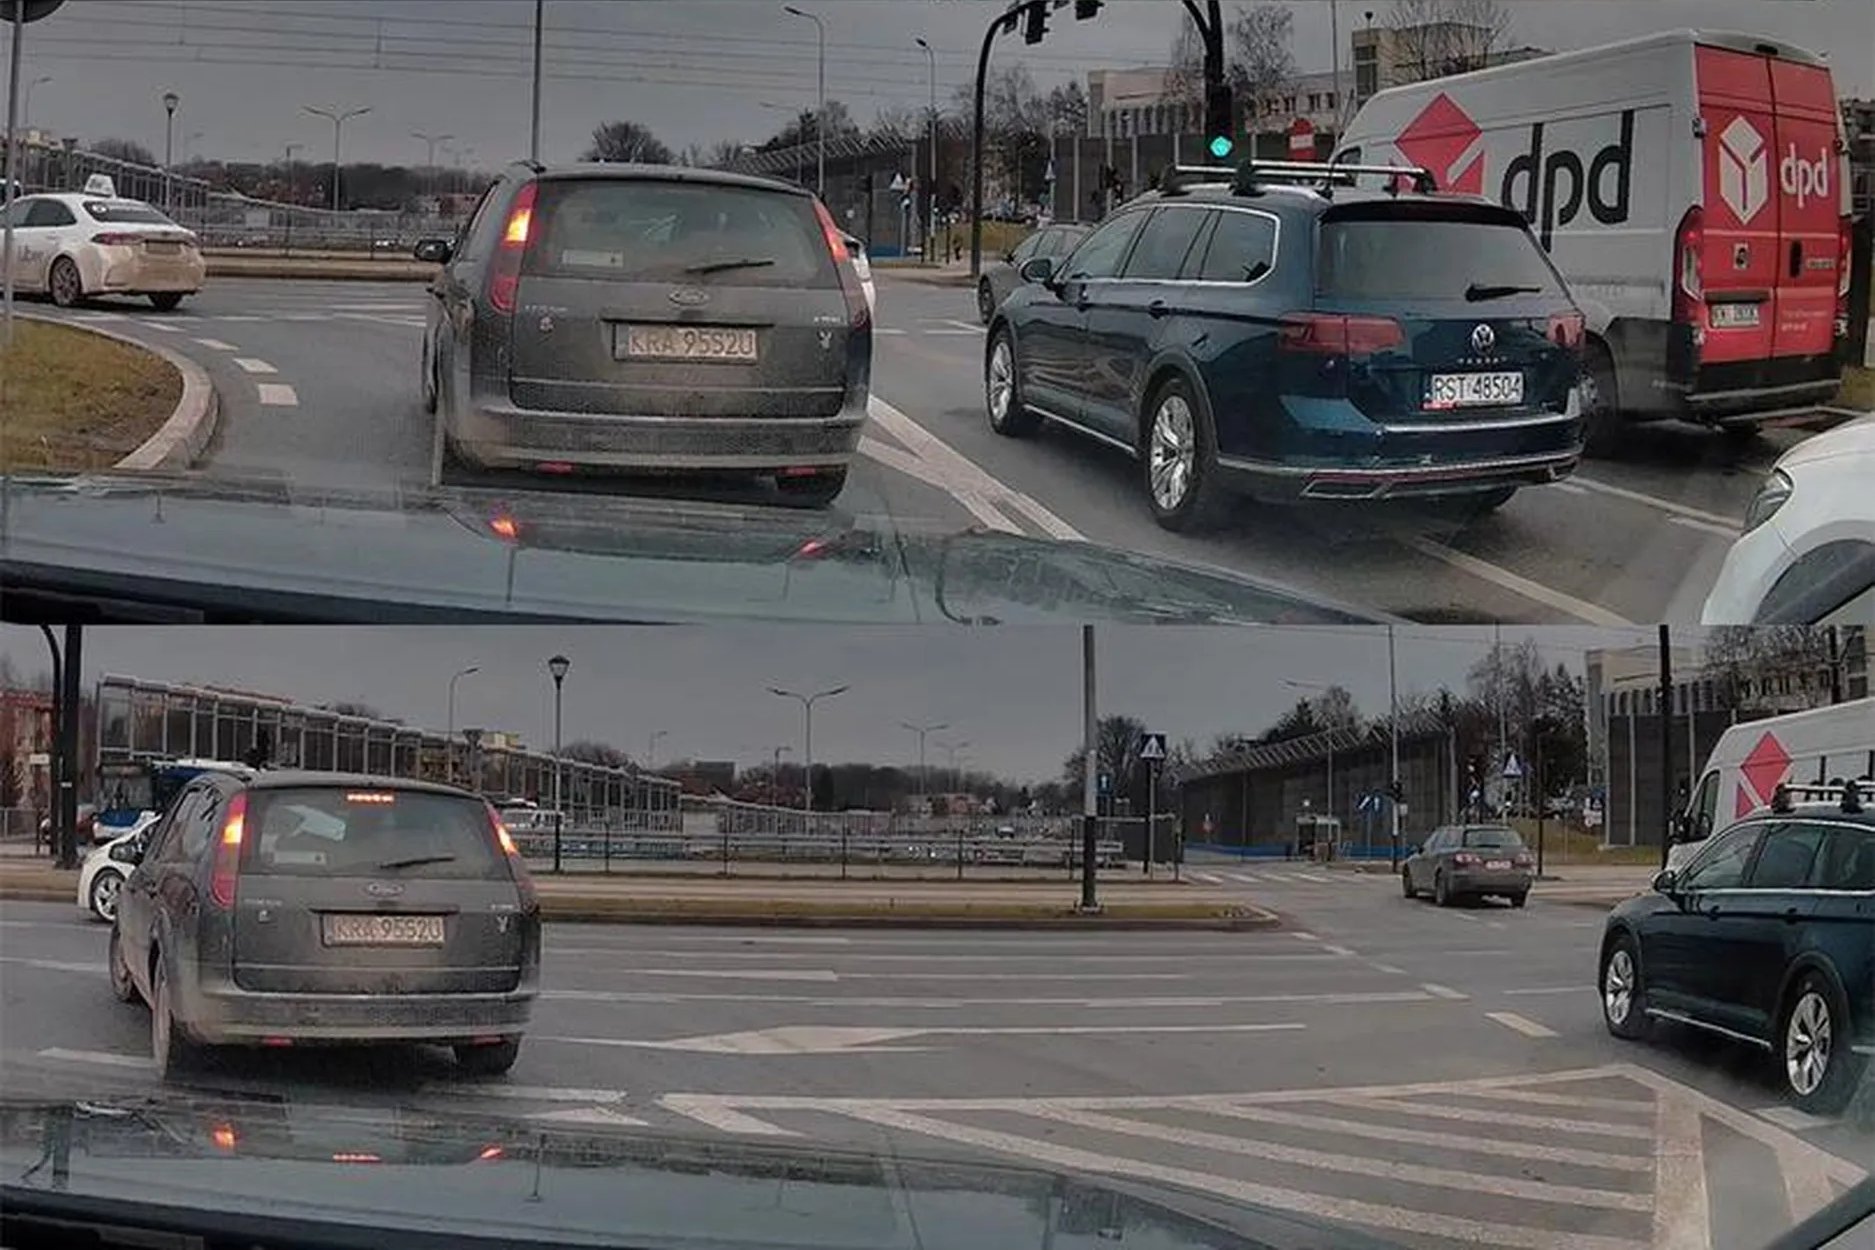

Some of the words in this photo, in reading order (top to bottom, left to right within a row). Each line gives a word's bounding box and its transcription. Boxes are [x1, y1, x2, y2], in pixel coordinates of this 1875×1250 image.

[1502, 110, 1635, 253] dpd
[1780, 142, 1828, 209] dpd
[629, 329, 675, 356] KRA
[1434, 375, 1466, 401] RST
[1472, 374, 1521, 400] 48504
